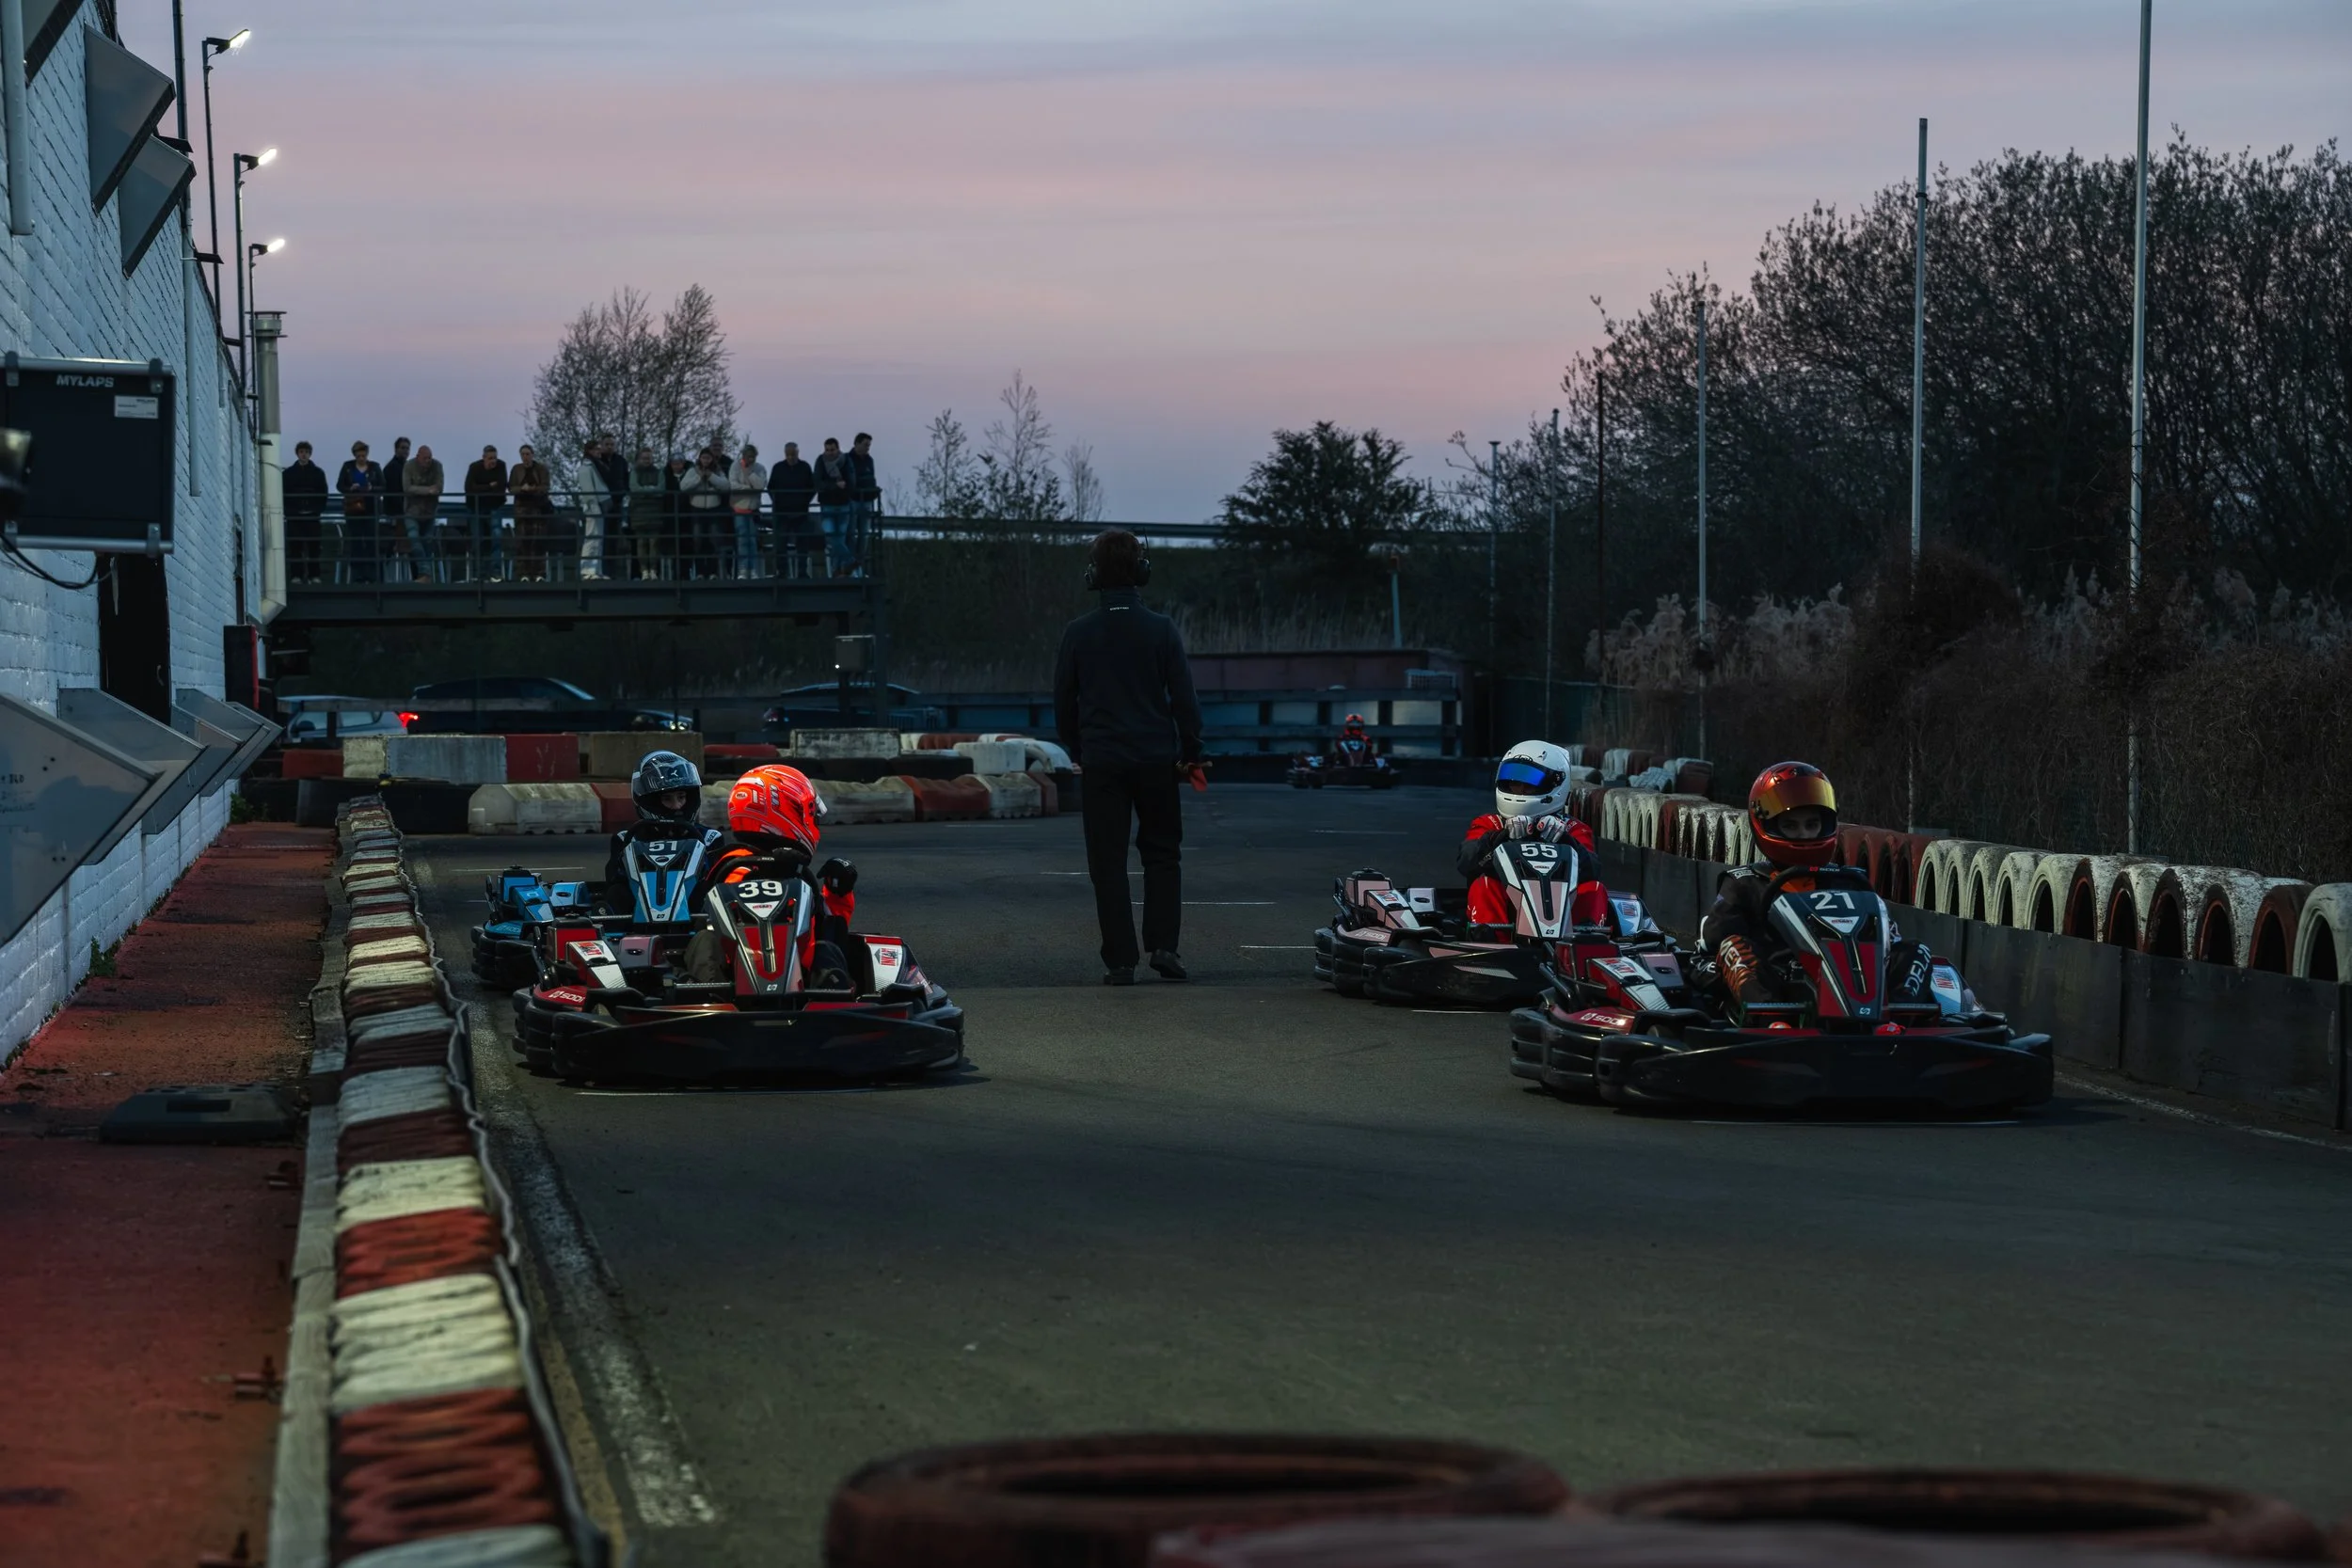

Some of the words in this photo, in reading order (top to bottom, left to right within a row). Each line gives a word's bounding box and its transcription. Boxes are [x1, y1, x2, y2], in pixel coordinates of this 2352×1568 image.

[56, 374, 114, 388] MYLAPS
[649, 841, 677, 851] 51
[1520, 844, 1558, 858] 55
[739, 880, 783, 897] 39
[1810, 892, 1855, 910] 21
[561, 991, 586, 1003] SODI
